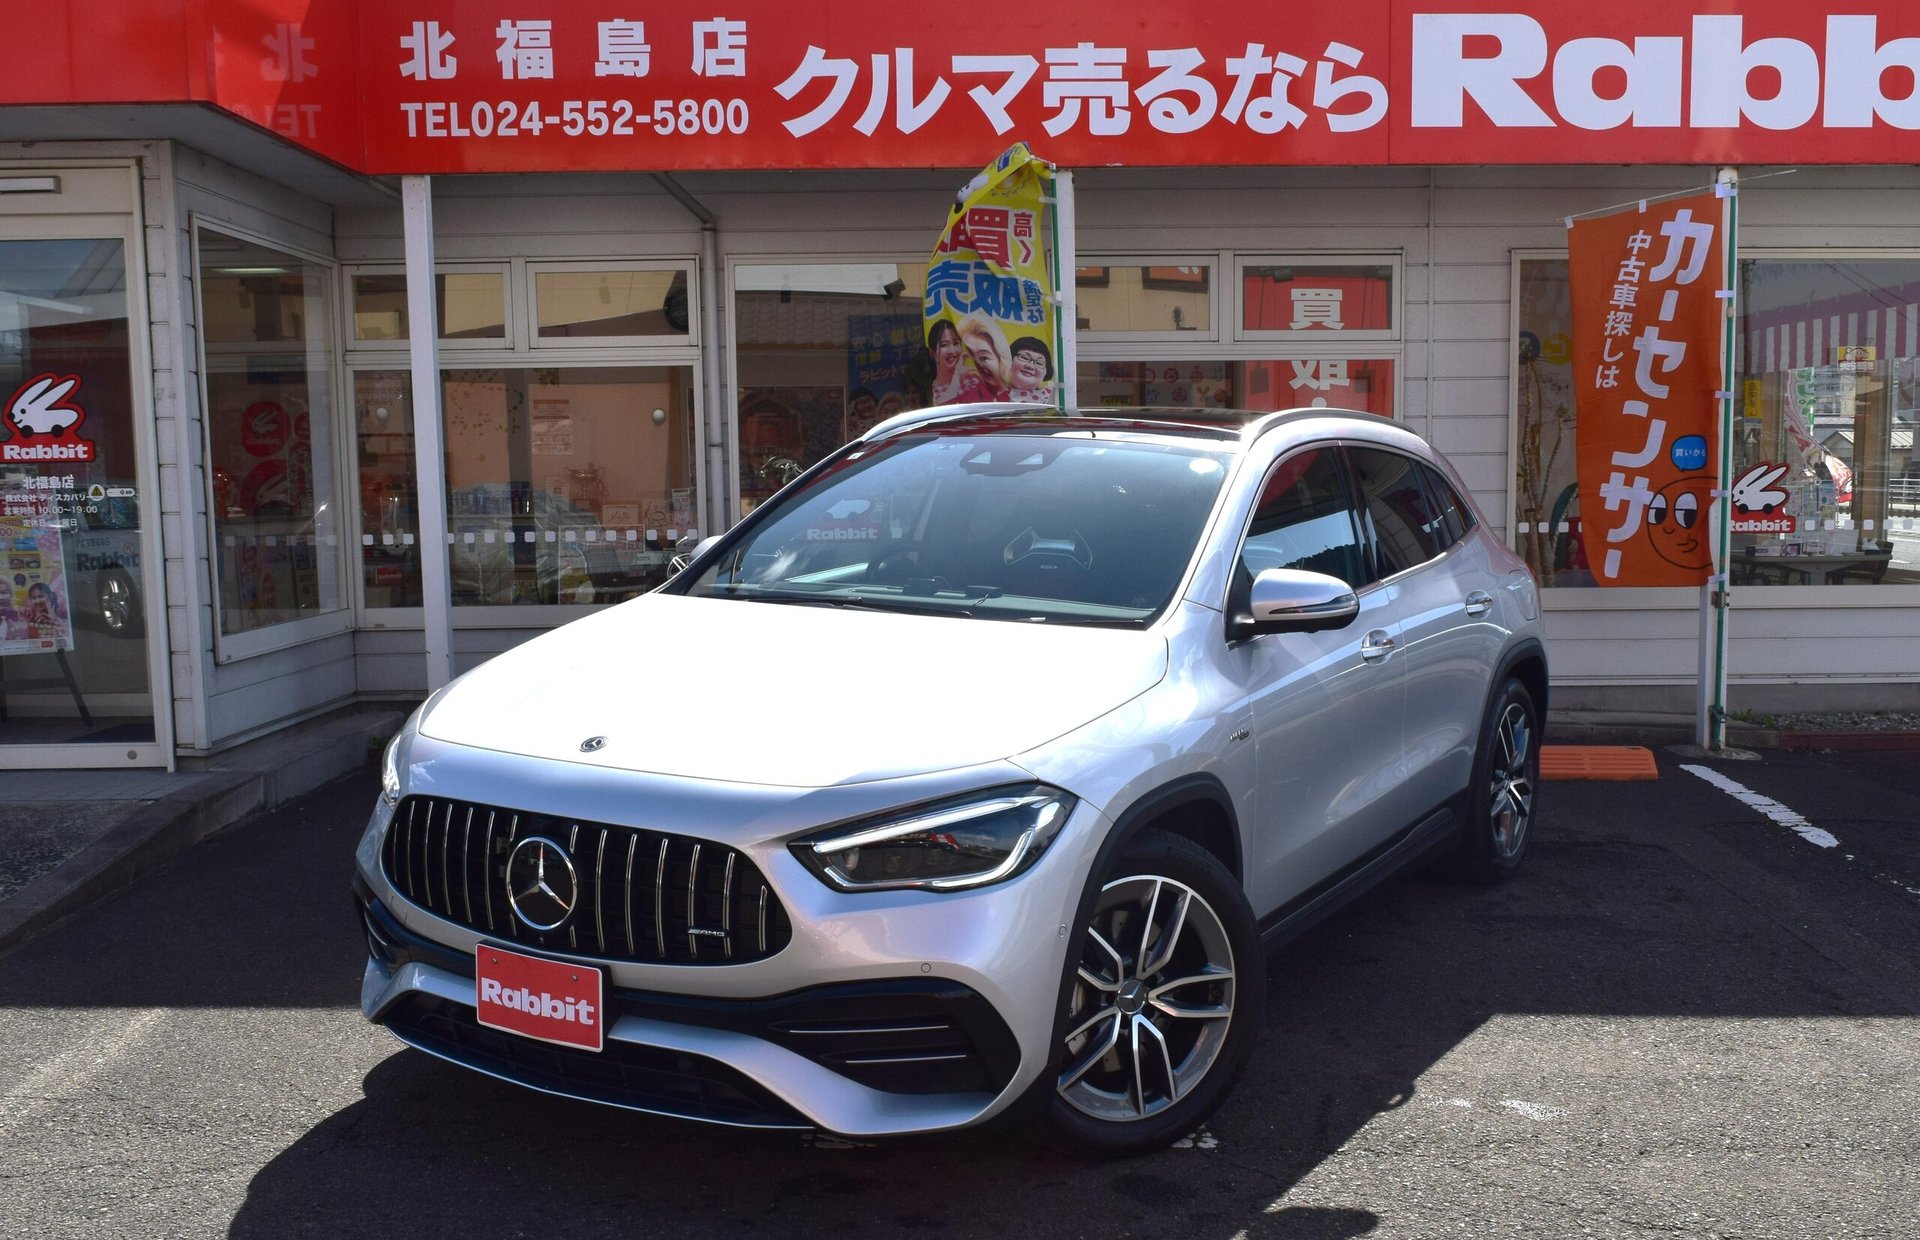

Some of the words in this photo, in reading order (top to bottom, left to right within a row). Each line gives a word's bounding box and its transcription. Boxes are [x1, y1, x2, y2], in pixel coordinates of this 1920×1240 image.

[399, 17, 747, 81] 北福島店
[1411, 13, 1920, 130] Rabb
[773, 41, 1389, 138] クルマ売るなら
[400, 98, 749, 138] TEL024-552-5800
[1596, 230, 1653, 388] 中古車探しは
[1600, 209, 1714, 579] カーセンサー
[3, 444, 88, 459] Rabbit
[23, 475, 75, 489] 北福島店
[807, 527, 878, 541] Rabbit
[699, 929, 725, 937] AMG
[481, 977, 595, 1025] Rabbit
